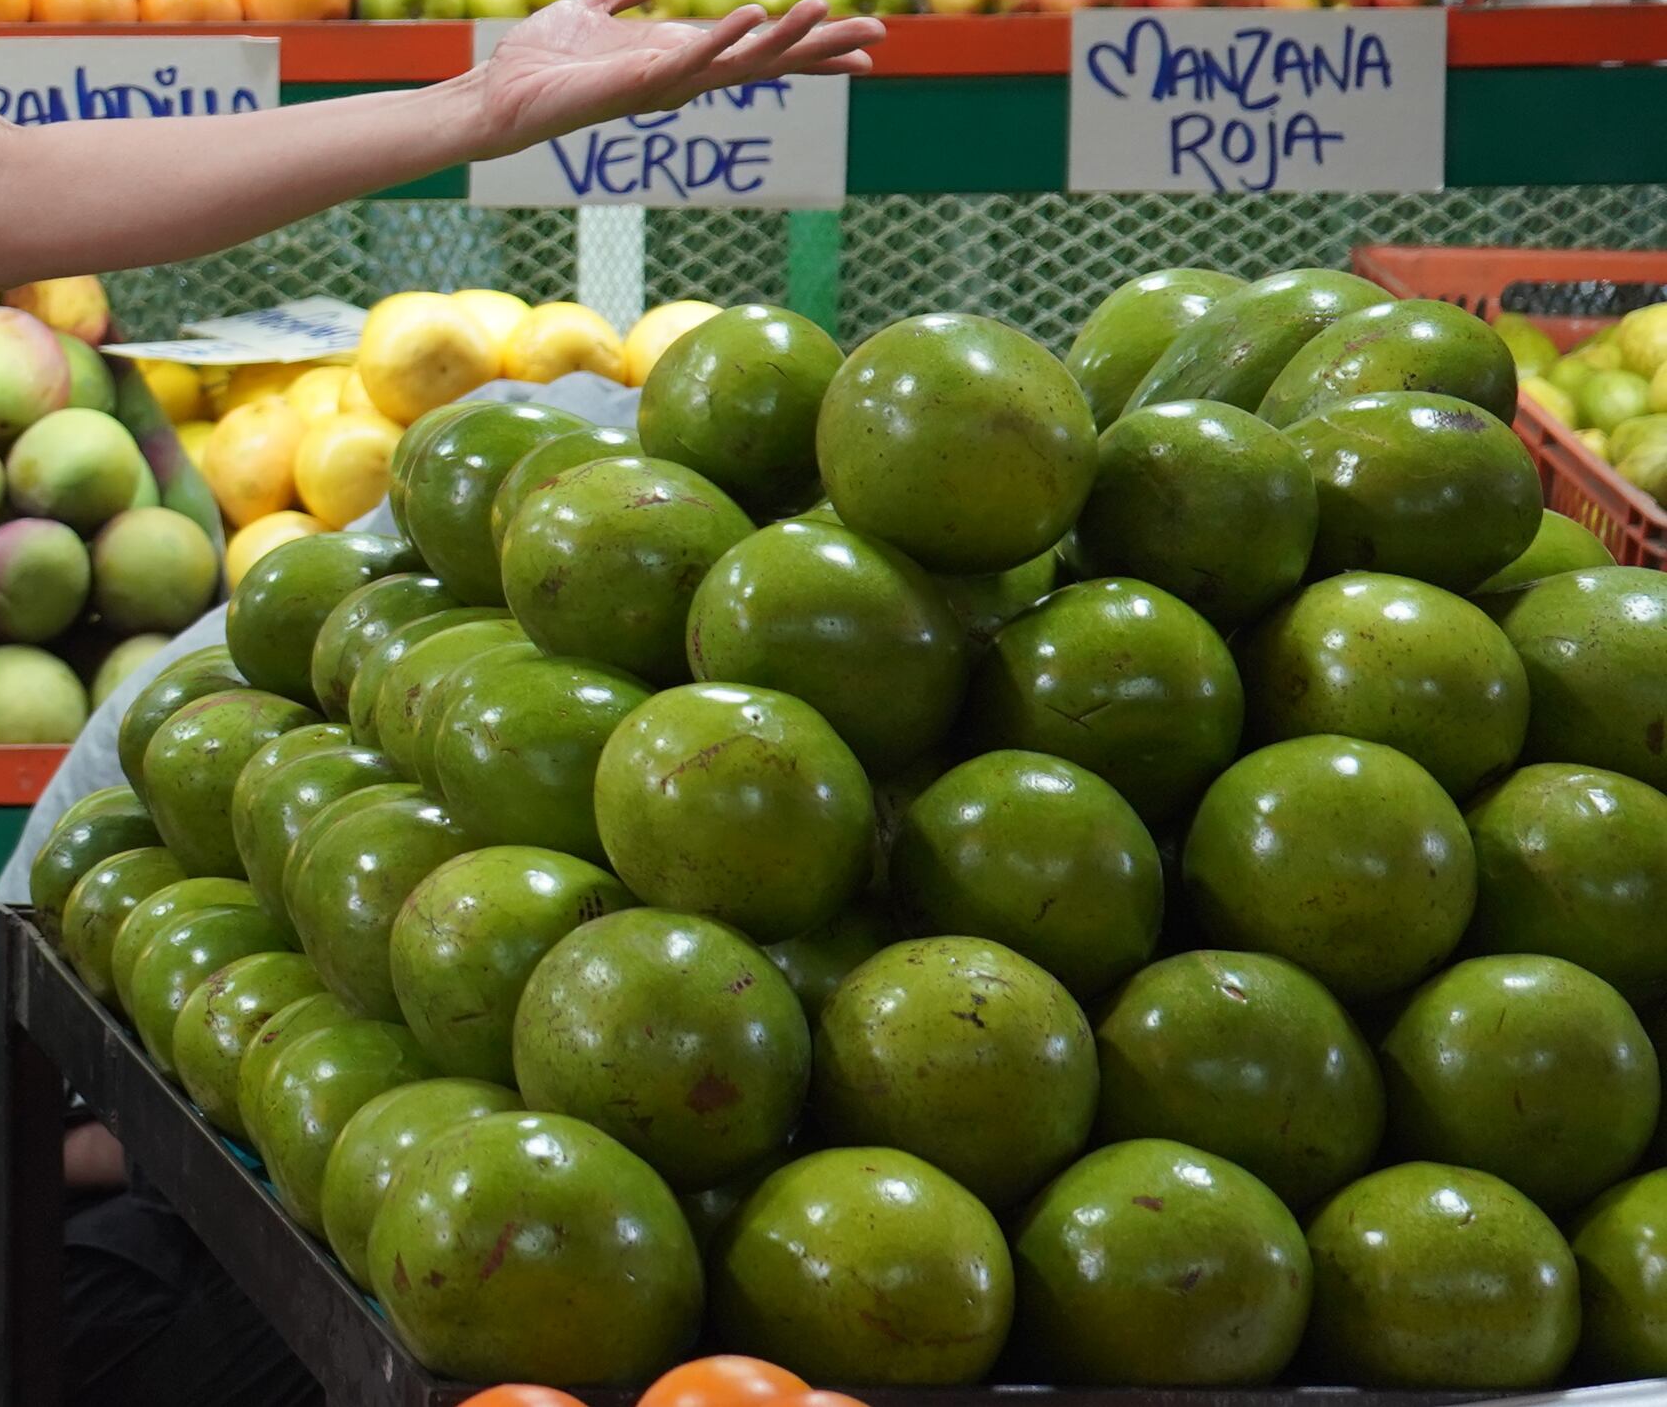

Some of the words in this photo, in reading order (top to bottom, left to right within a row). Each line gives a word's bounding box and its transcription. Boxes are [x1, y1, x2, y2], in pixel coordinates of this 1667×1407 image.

[1087, 17, 1392, 110] MANZANA
[547, 129, 772, 199] VERDE
[1171, 111, 1345, 193] ROJA
